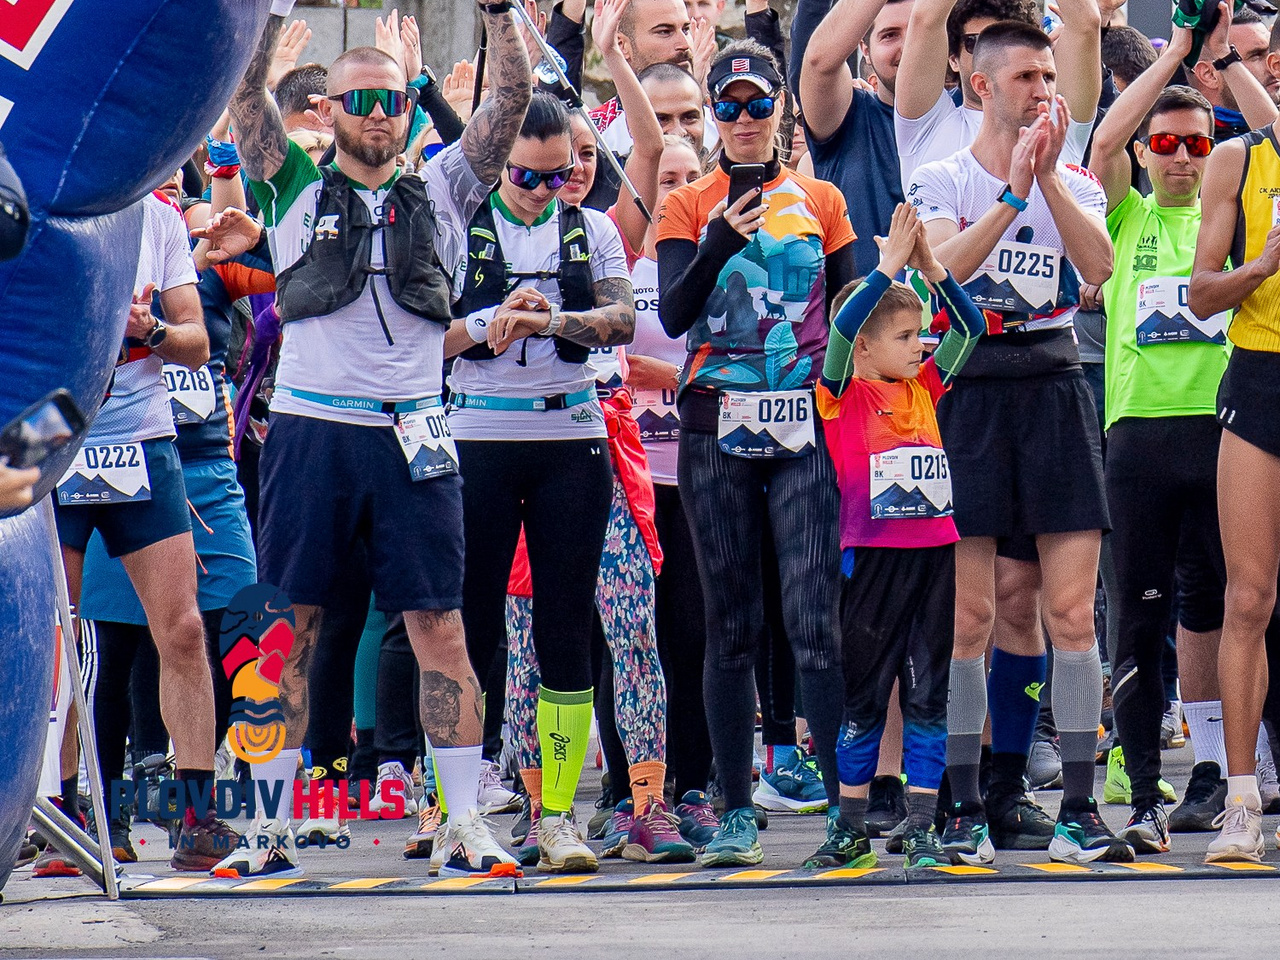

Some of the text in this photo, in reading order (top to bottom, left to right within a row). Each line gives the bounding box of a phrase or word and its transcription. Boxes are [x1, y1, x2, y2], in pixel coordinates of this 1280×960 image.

[998, 249, 1054, 279] 0225
[163, 370, 210, 392] 0218
[332, 398, 375, 409] GARMIN
[758, 397, 808, 423] 0216
[84, 445, 140, 469] 0222
[911, 454, 948, 480] 0215
